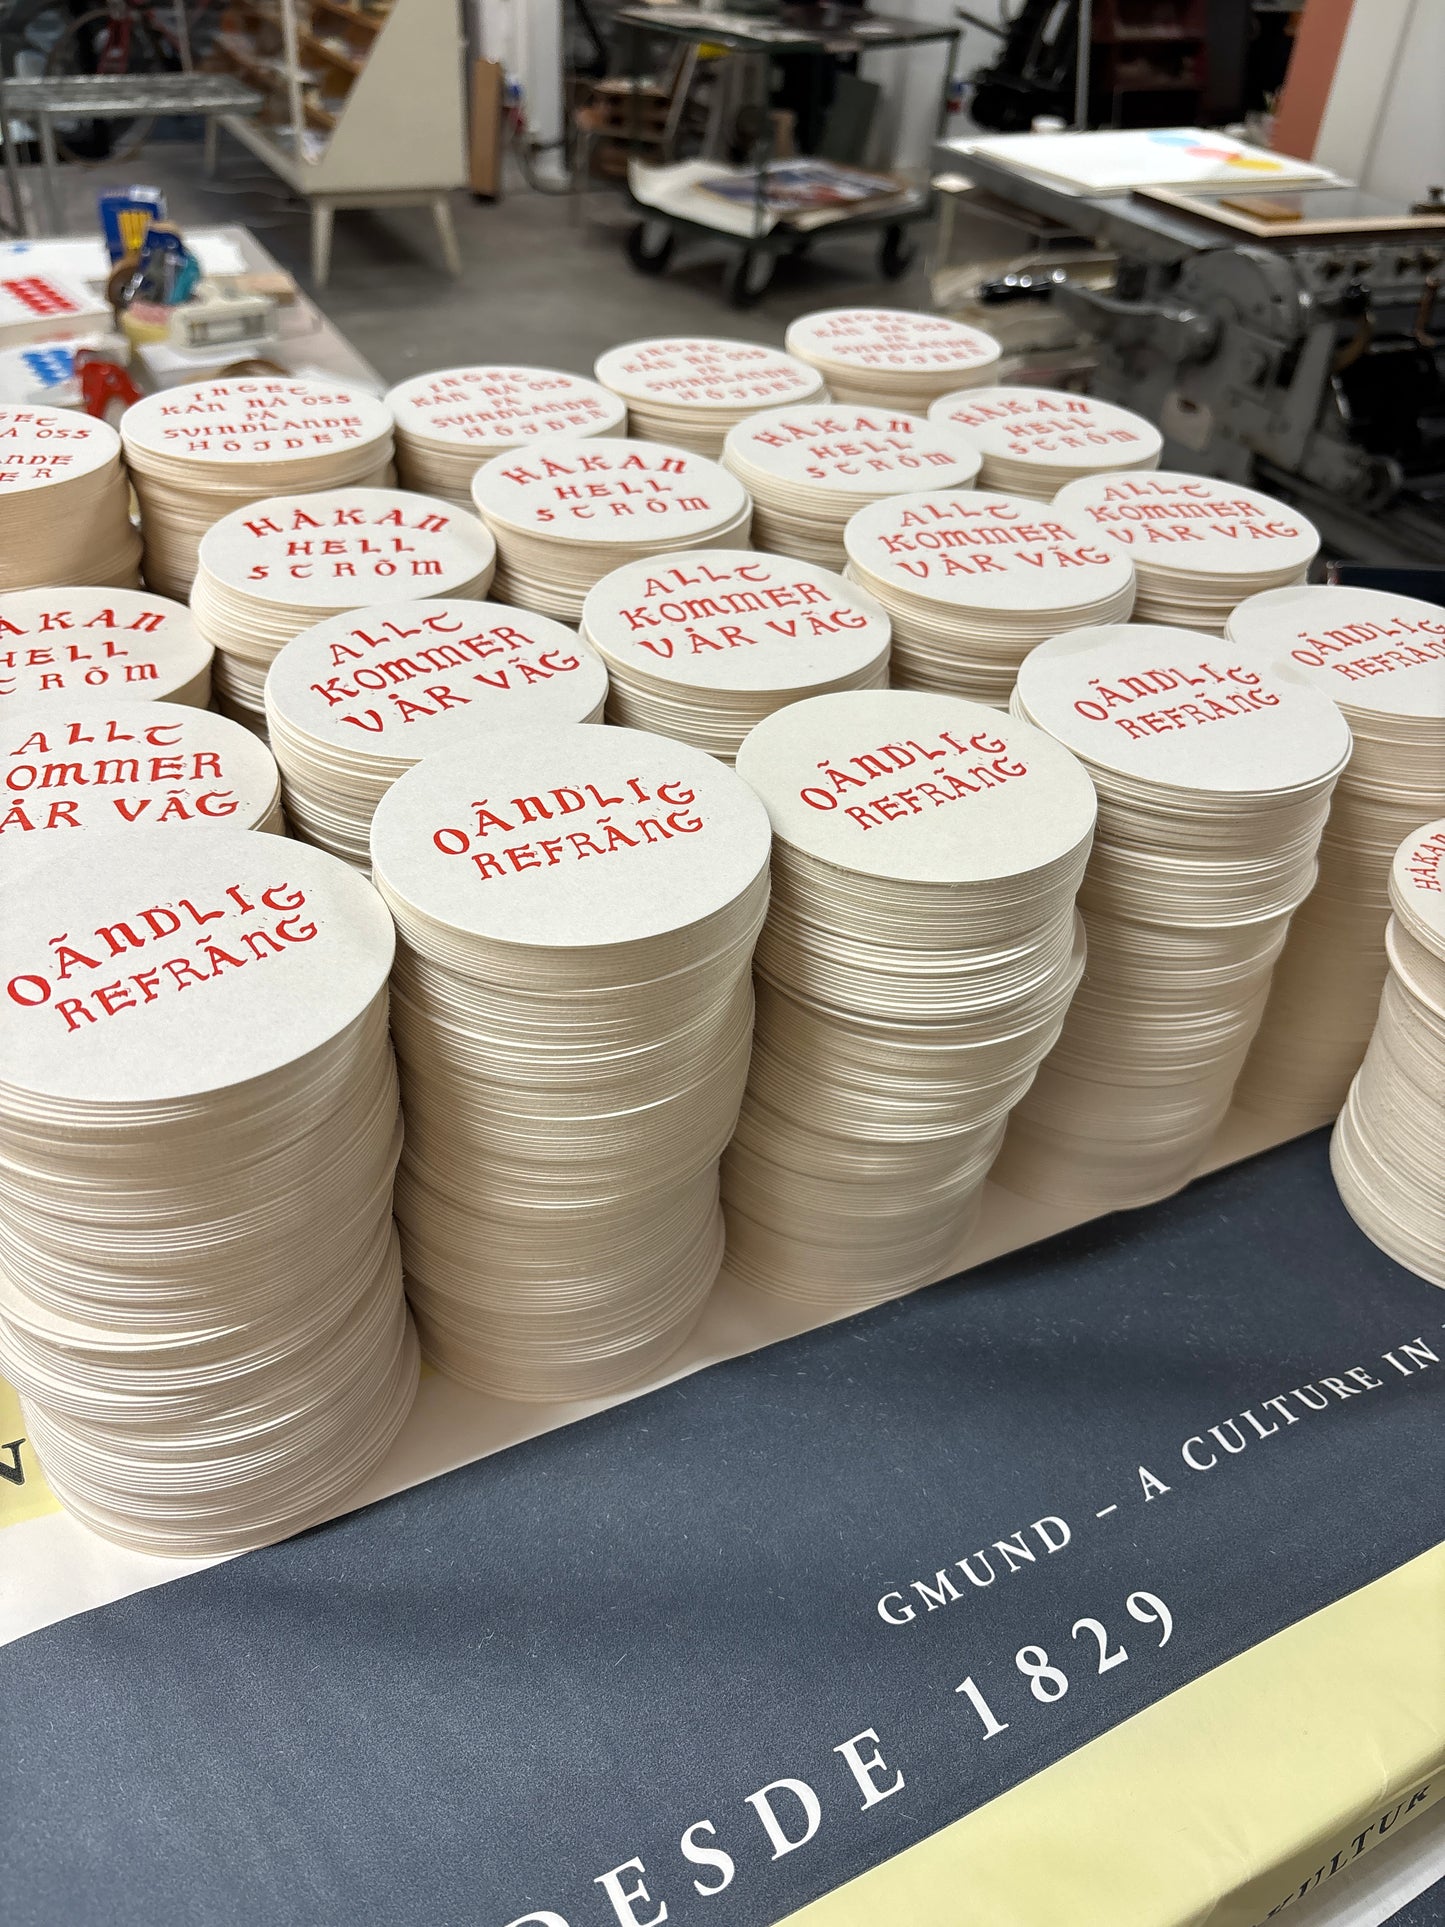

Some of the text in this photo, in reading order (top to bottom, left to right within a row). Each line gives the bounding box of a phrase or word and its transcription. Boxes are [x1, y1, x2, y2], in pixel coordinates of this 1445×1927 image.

[302, 394, 351, 406] OSS
[36, 429, 92, 440] OSS
[808, 437, 914, 460] HELL
[556, 478, 673, 500] HELL
[1083, 500, 1266, 526] KOMMER
[286, 537, 416, 556] HELL
[877, 522, 1077, 554] KOMMER
[619, 582, 833, 631] KOMMER
[0, 608, 166, 639] ÅKAN
[637, 625, 758, 659] VÅR
[310, 625, 535, 706] KOMMER
[340, 686, 472, 734] VÅR
[6, 752, 224, 792] OMMER
[0, 798, 83, 835] ÅR
[877, 1515, 1072, 1625] GMUND
[1138, 1465, 1171, 1502] A
[1181, 1366, 1383, 1471] CULTURE
[1382, 1337, 1440, 1376] IN
[503, 1590, 1174, 1927] ESDE 1829
